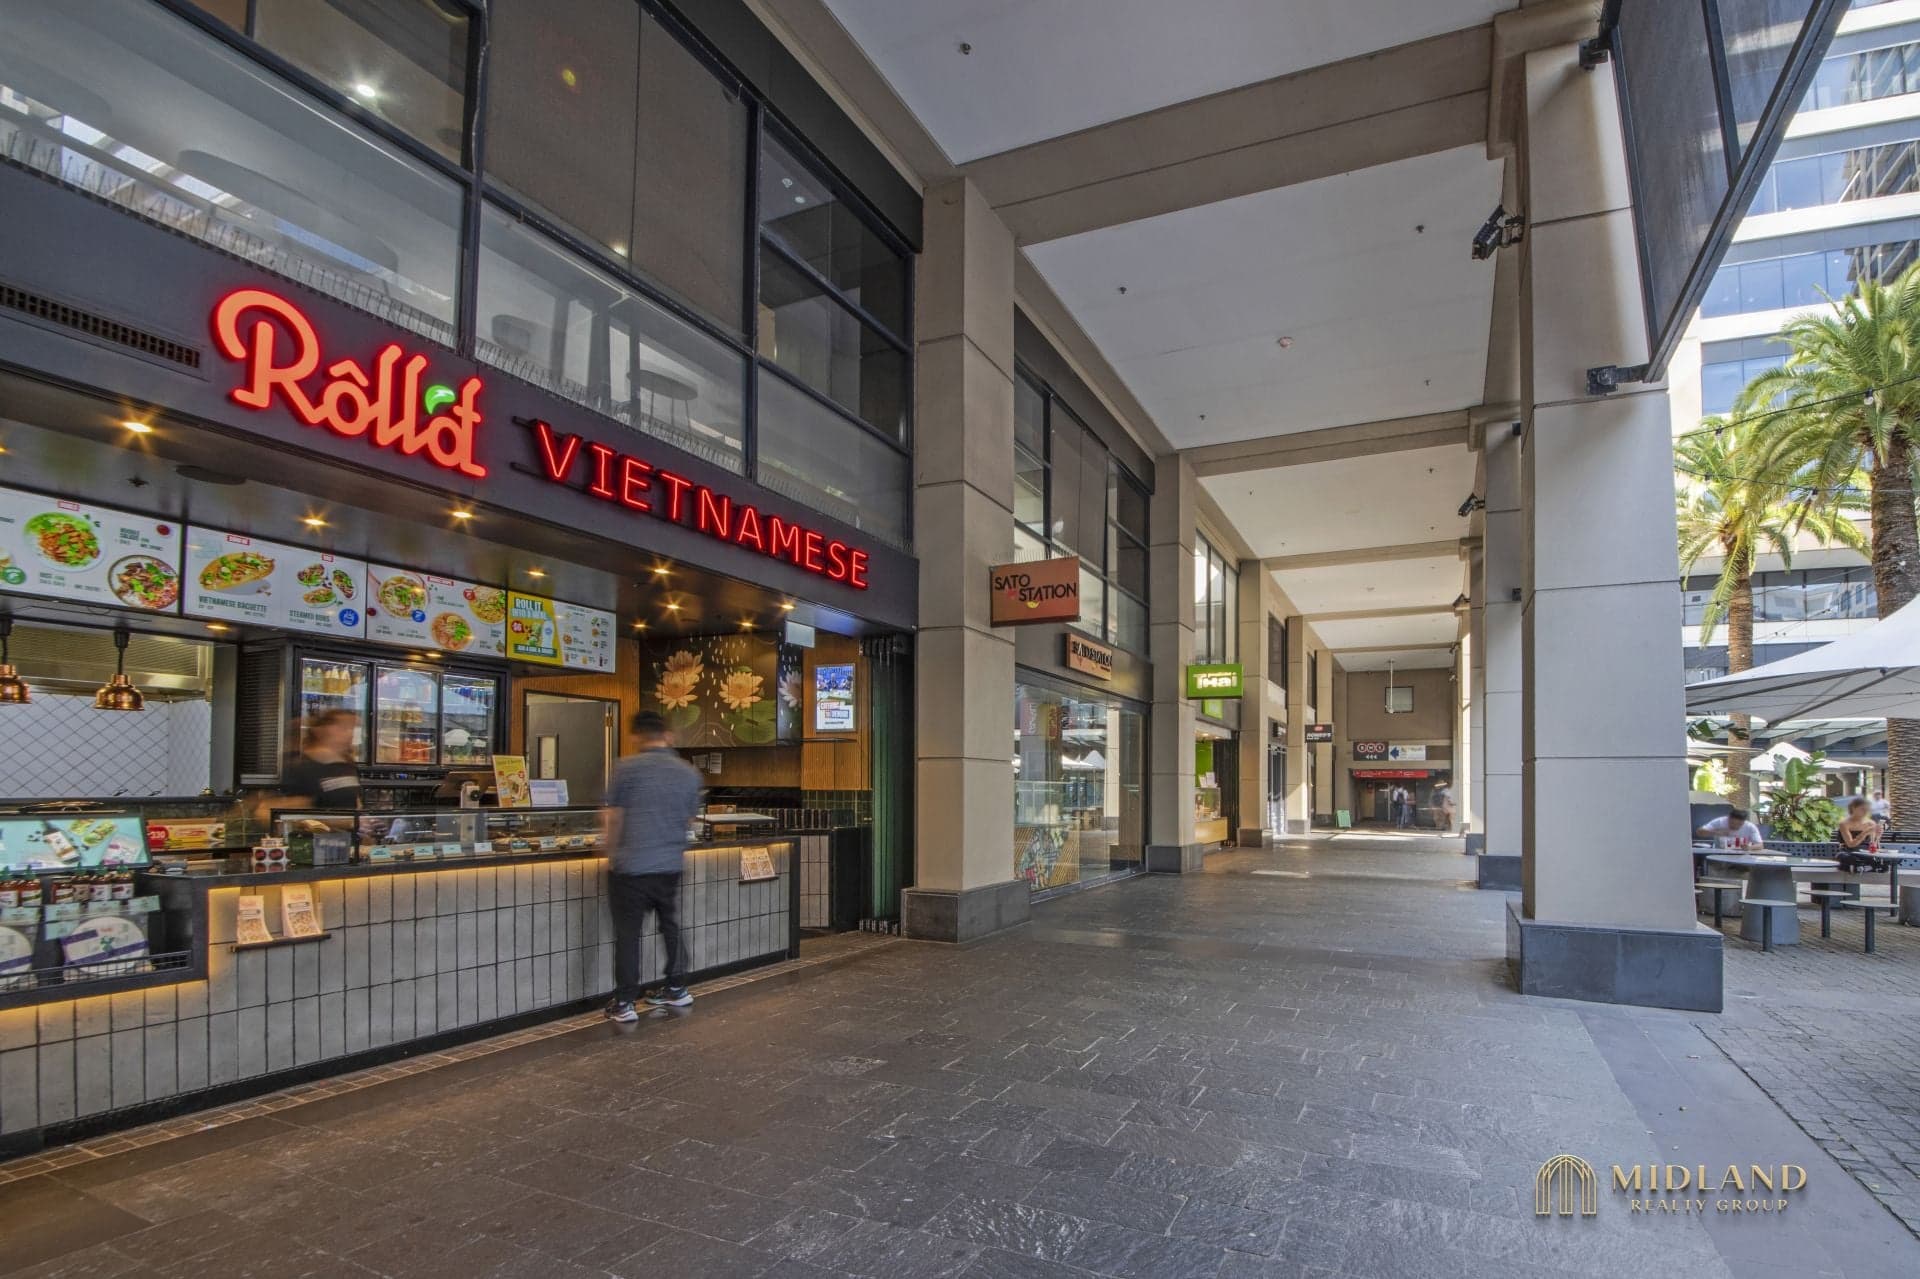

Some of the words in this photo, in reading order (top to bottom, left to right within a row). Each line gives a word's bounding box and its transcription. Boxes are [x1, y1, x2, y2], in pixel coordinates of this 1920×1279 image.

[532, 419, 870, 589] VIETNAMESE
[994, 574, 1030, 591] SATO
[1018, 582, 1078, 602] STATION
